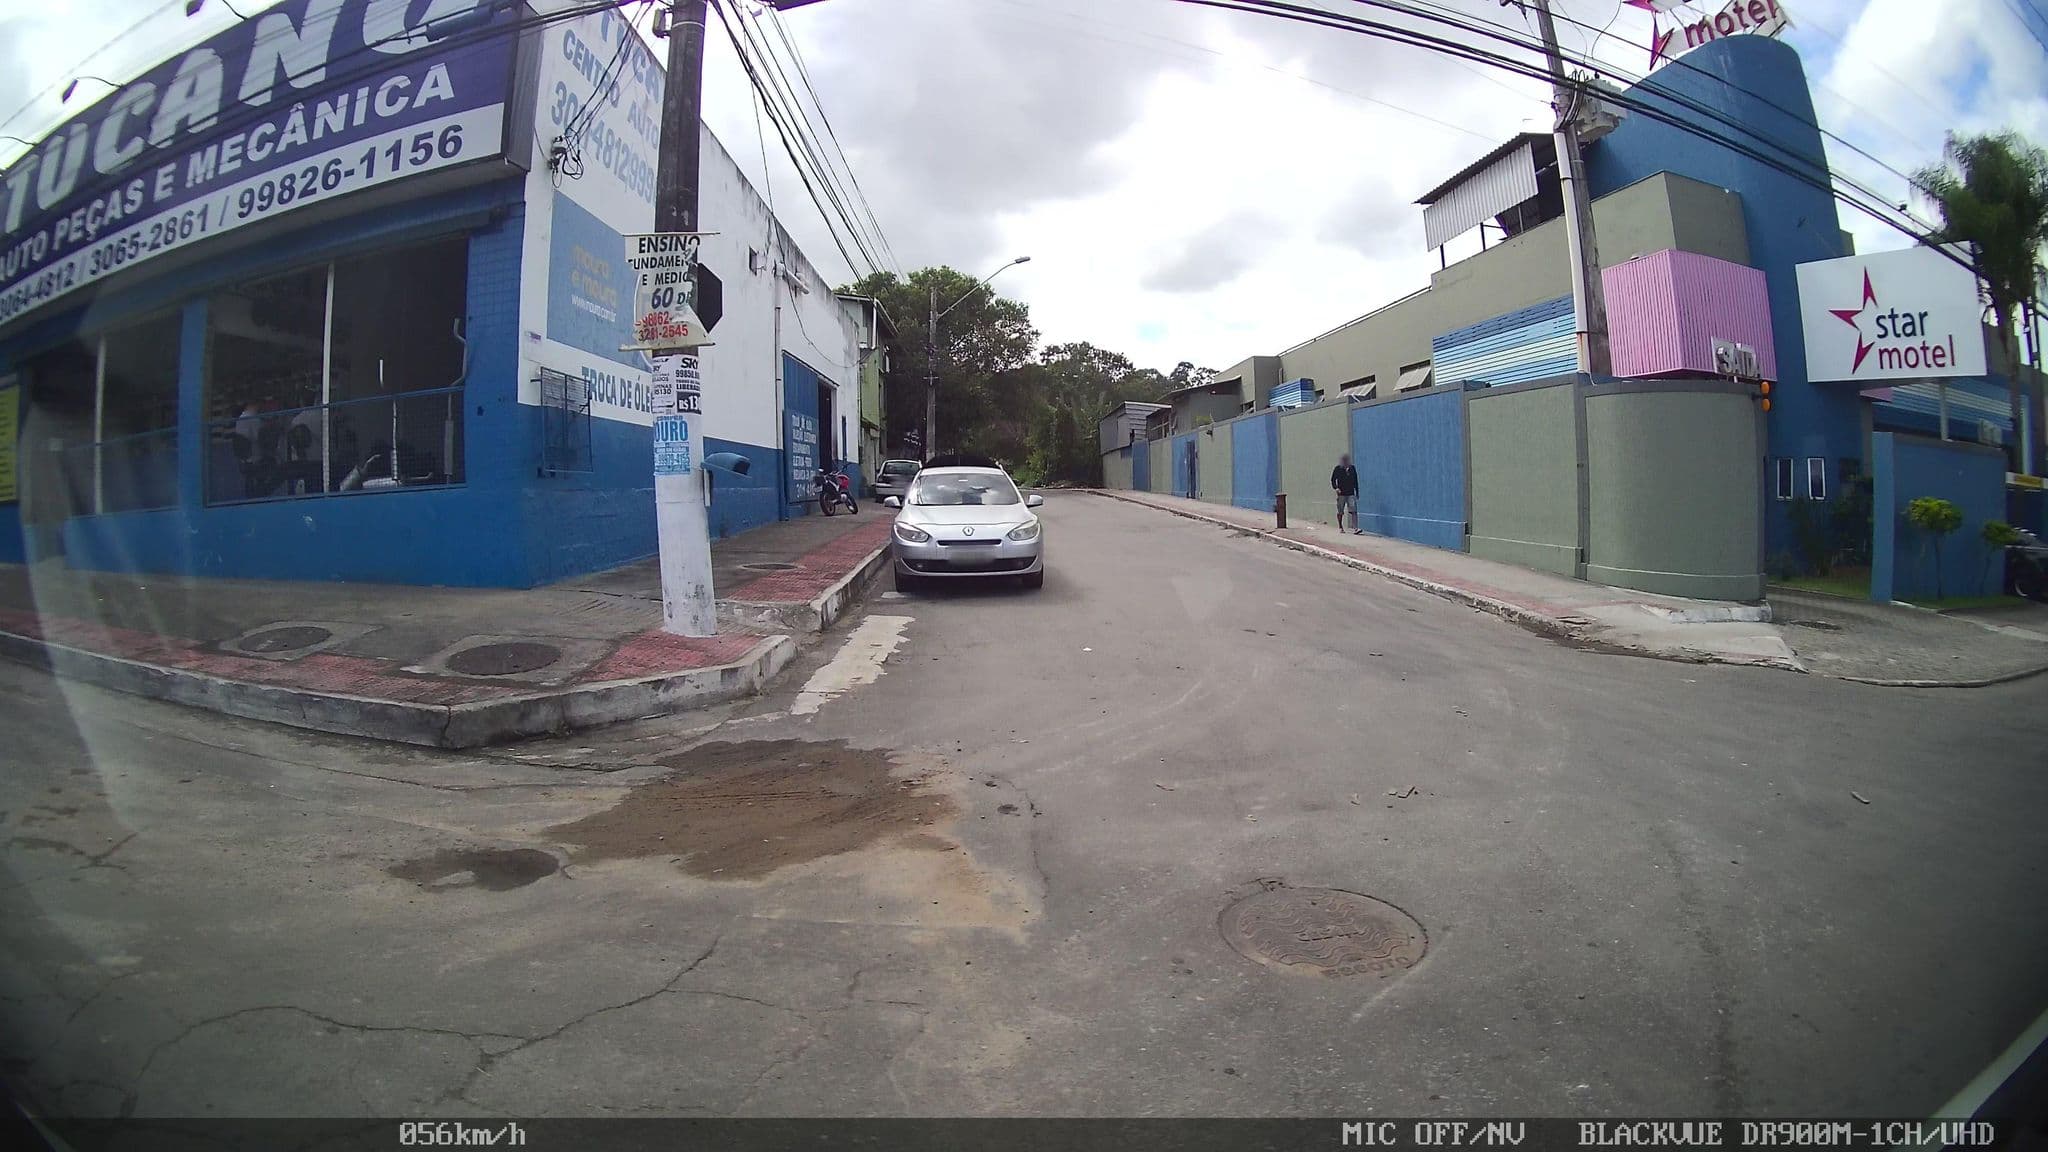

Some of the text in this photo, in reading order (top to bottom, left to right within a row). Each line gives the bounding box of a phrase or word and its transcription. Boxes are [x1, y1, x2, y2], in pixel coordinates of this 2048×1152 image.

[1684, 0, 1778, 48] motel
[563, 29, 620, 109] CENTRO
[53, 179, 145, 251] PEÇAS
[154, 163, 177, 202] E
[186, 62, 455, 189] MECÂNICA
[90, 203, 209, 276] 3065-2861
[238, 125, 463, 219] 99826-1156
[642, 274, 648, 286] E
[651, 286, 674, 309] 60
[1875, 307, 1929, 339] star
[1878, 334, 1956, 370] motel
[581, 366, 653, 414] TROCA DE ÓLE
